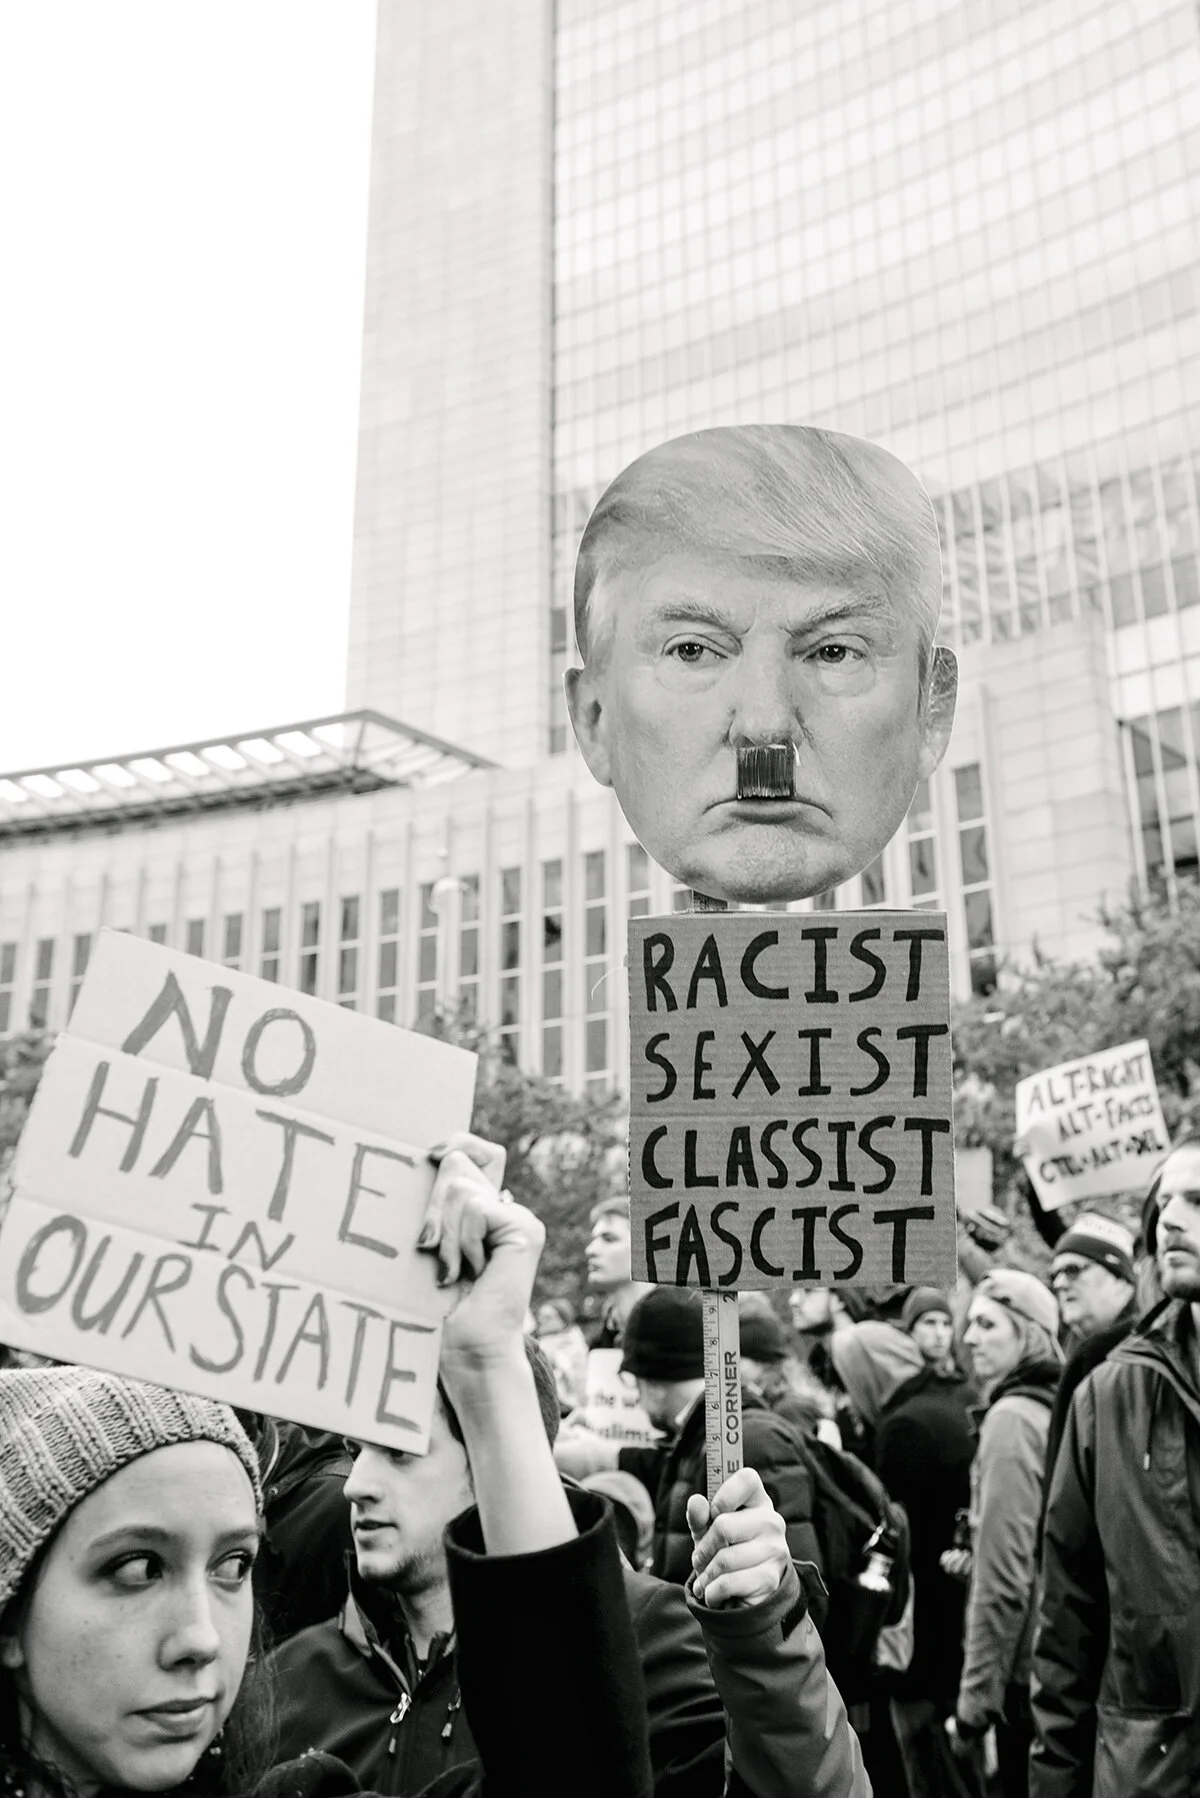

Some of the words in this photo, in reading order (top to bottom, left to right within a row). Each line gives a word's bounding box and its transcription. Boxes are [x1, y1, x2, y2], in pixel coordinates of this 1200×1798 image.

[643, 927, 945, 1012] RACIST
[121, 969, 317, 1097] NO
[645, 1024, 949, 1103] SEXIST
[69, 1061, 417, 1259] HATE
[641, 1116, 950, 1196] CLASSIST
[178, 1203, 295, 1272] IN
[645, 1201, 935, 1287] FASCIST
[15, 1215, 192, 1353] OUR
[190, 1264, 437, 1432] STATE
[724, 1351, 739, 1445] CORNER
